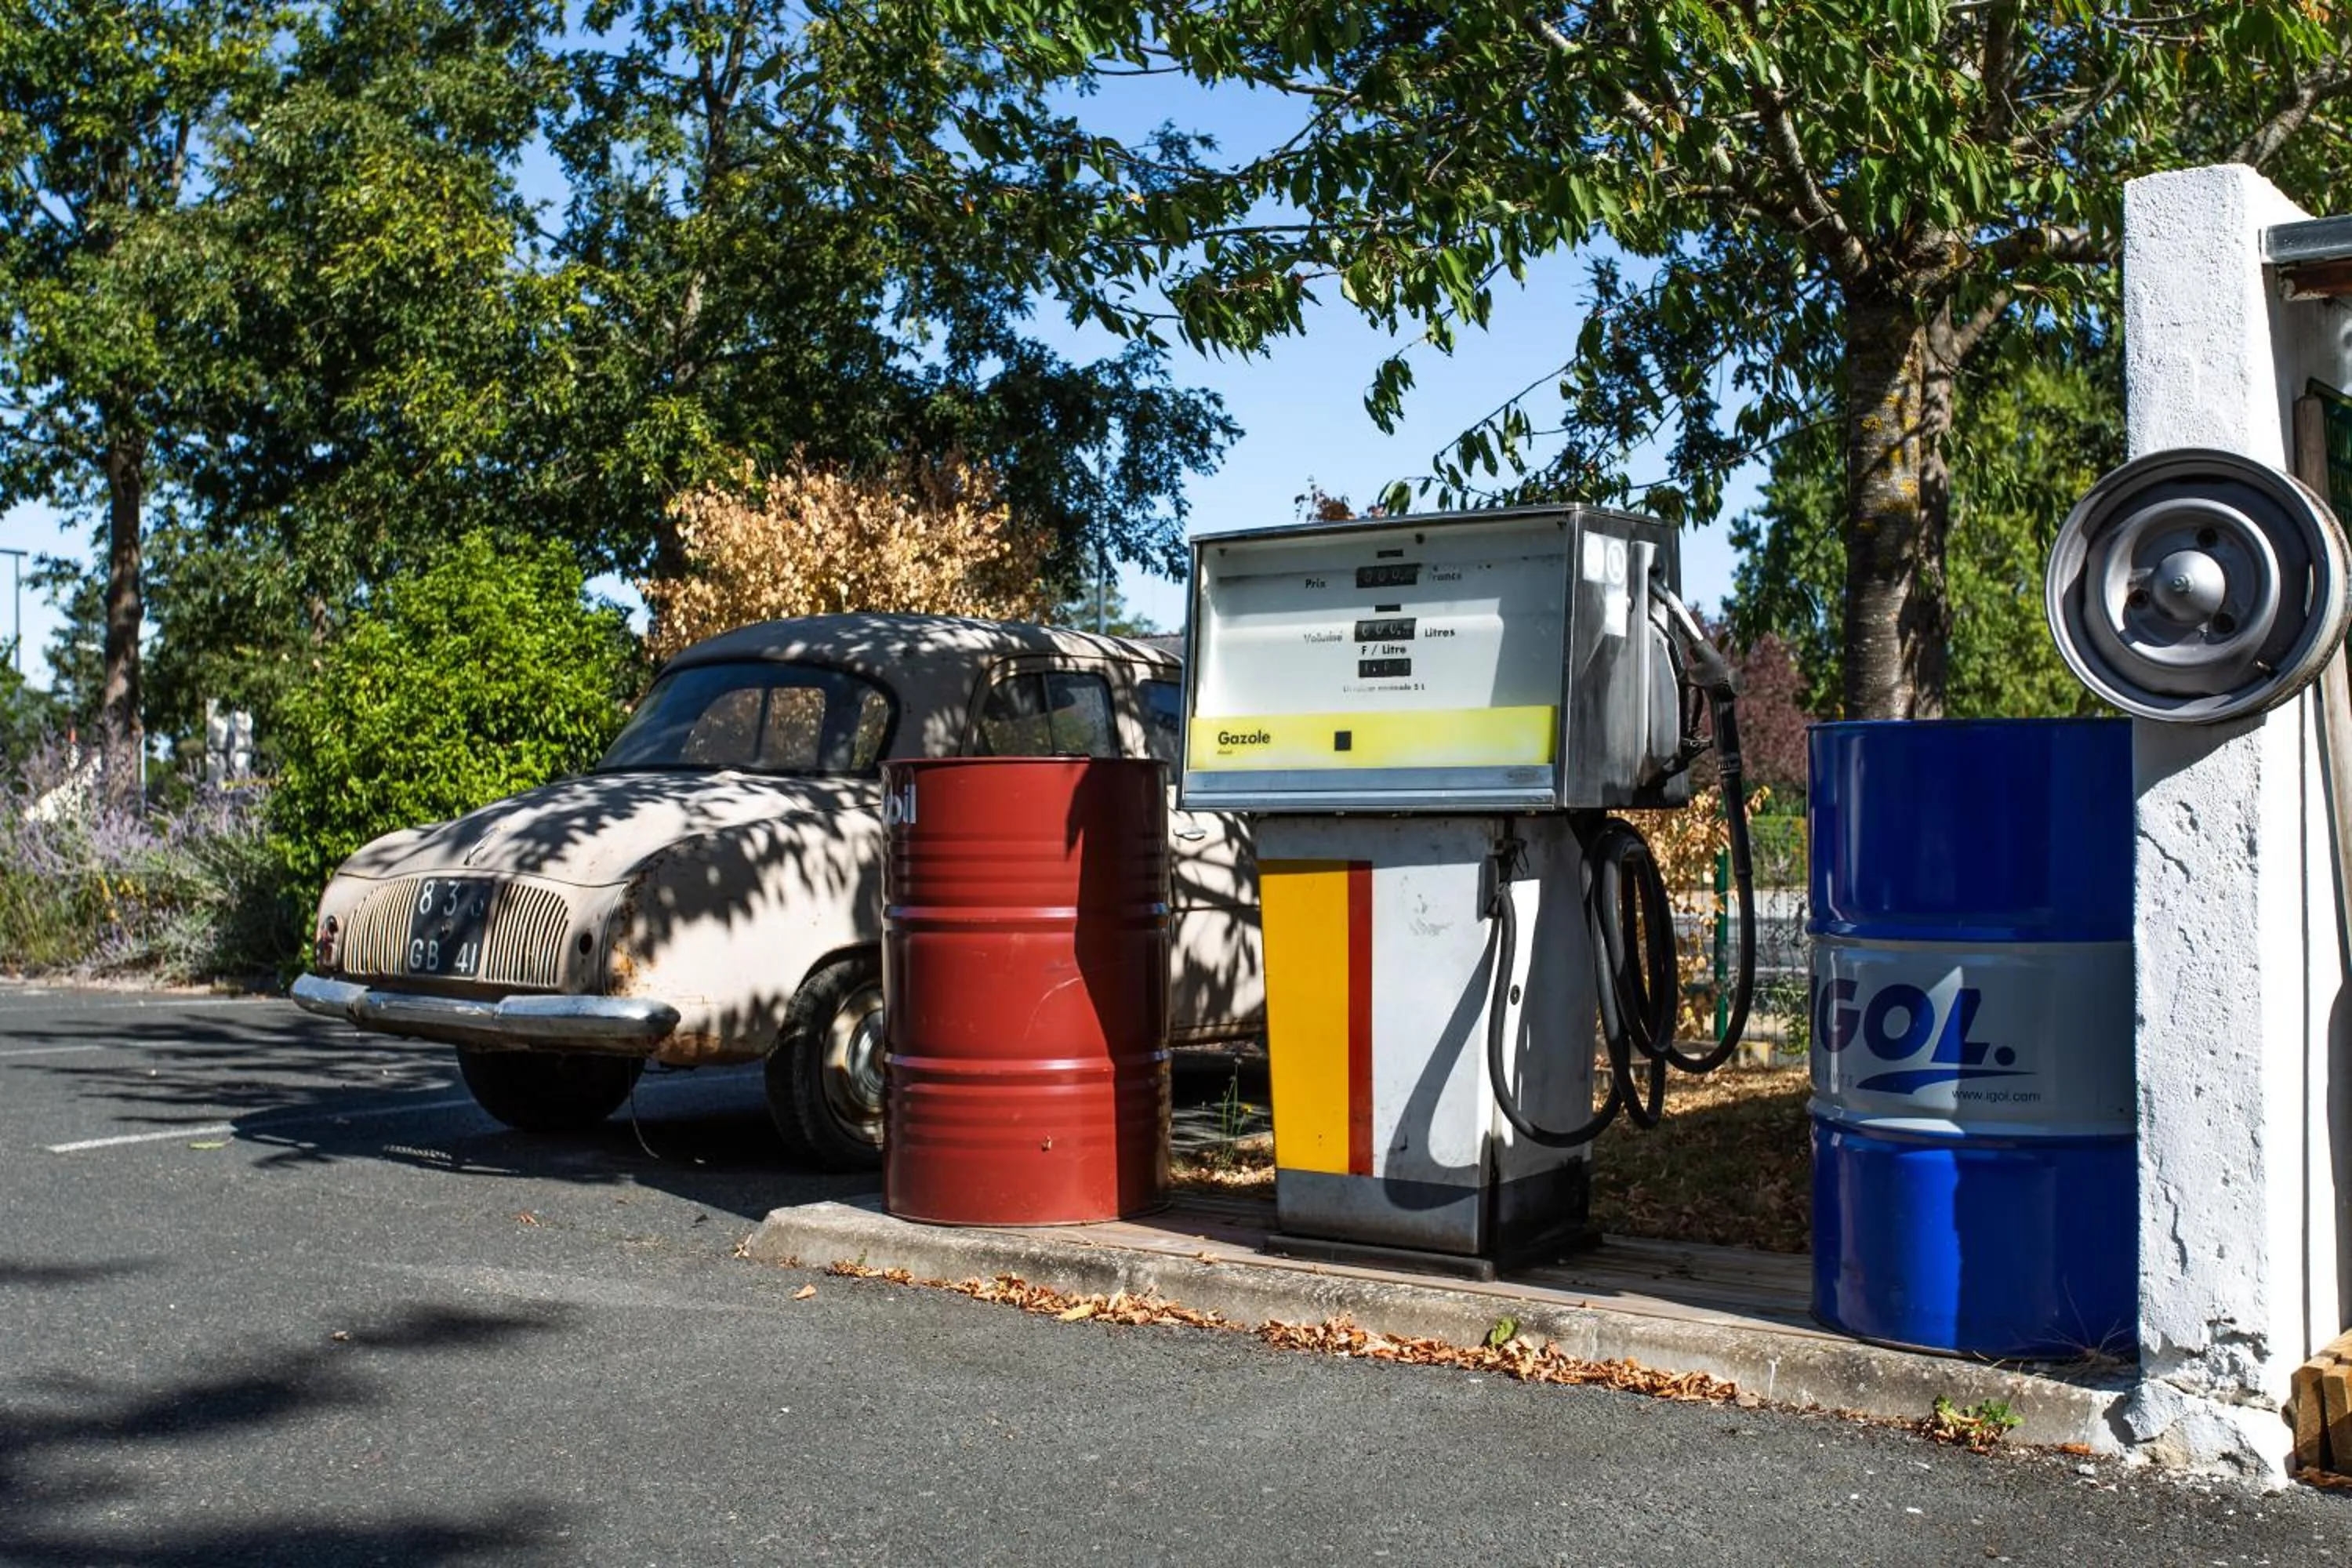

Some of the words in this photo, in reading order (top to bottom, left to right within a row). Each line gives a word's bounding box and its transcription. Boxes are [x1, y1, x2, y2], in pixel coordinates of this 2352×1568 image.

[1425, 626, 1456, 637] Litres
[1361, 645, 1367, 655] F
[1382, 644, 1406, 655] Litre
[1218, 729, 1271, 745] Gazole
[882, 784, 916, 825] bil
[409, 938, 439, 971] GB
[455, 942, 477, 973] 41
[1952, 1087, 2042, 1104] www.igol.com
